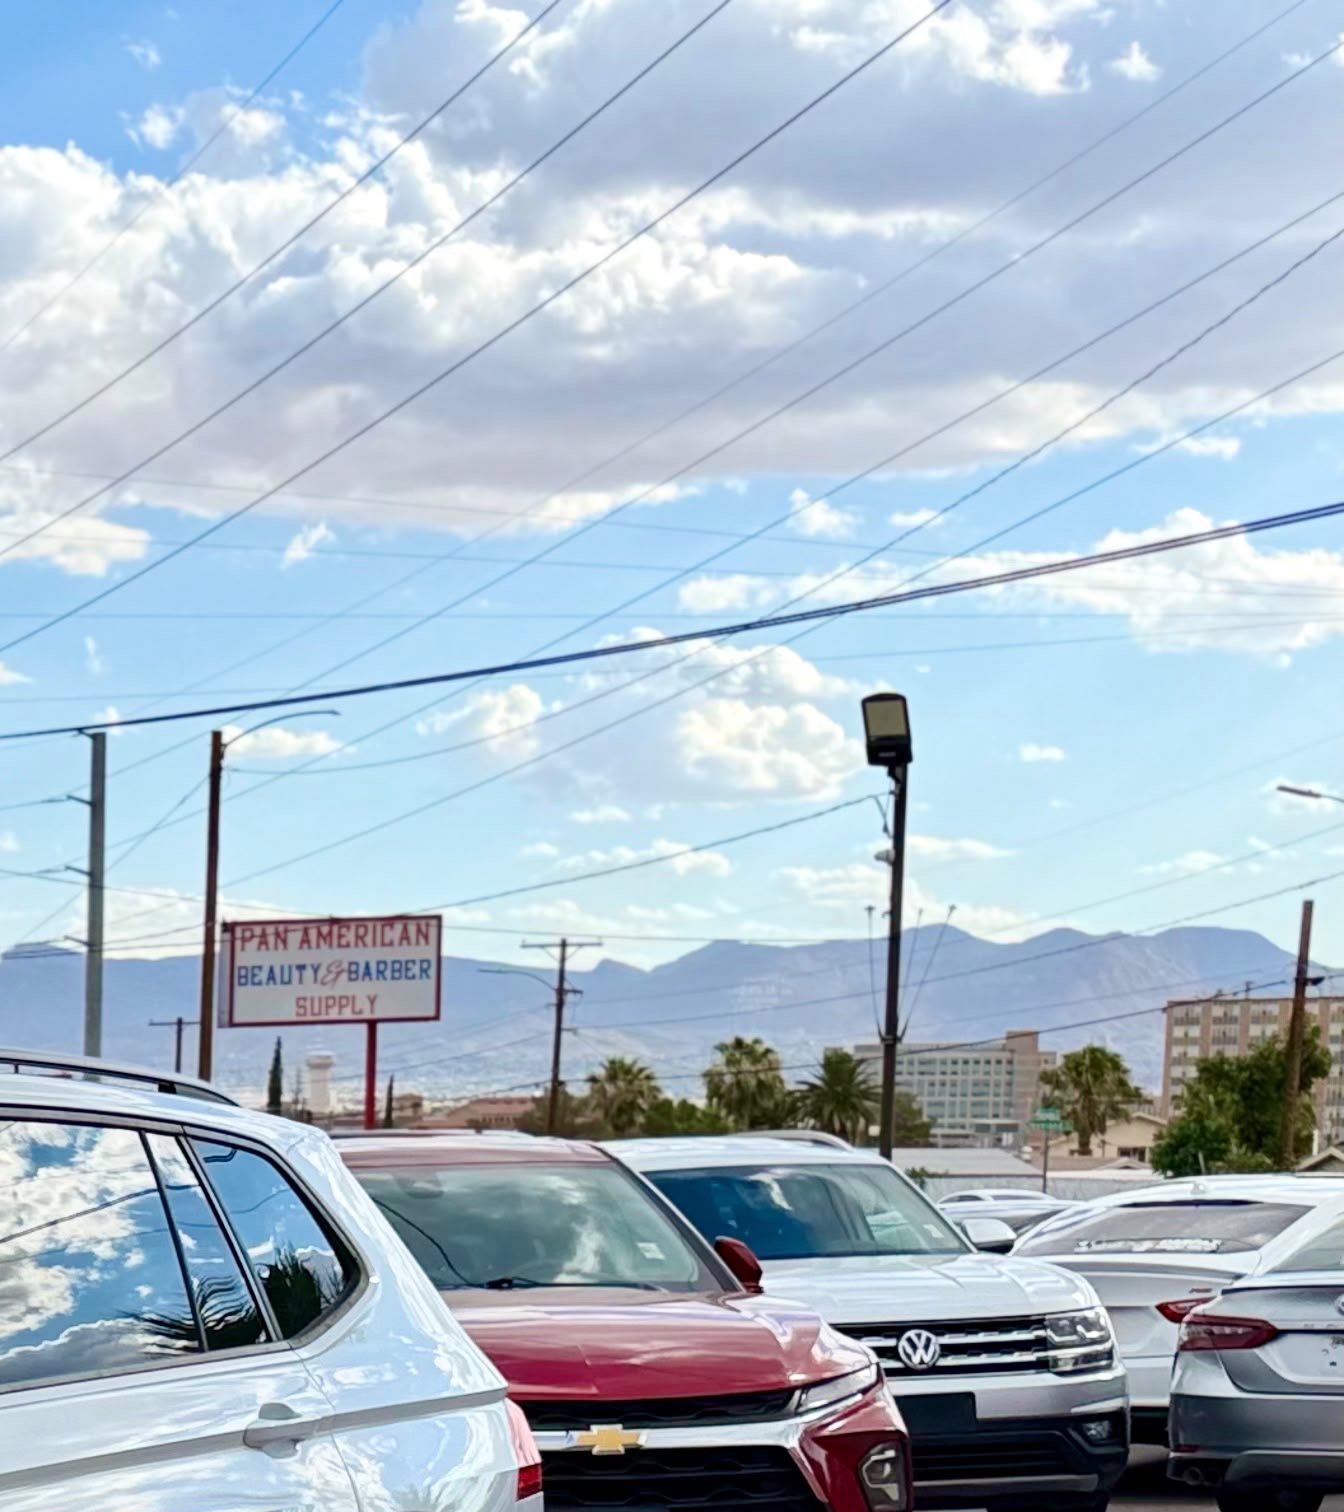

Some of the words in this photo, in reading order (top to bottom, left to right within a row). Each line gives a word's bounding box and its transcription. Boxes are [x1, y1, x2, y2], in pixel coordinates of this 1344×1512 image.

[240, 927, 288, 951] PAN
[298, 921, 430, 950] AMERICAN
[237, 963, 321, 986] BEAUTY
[320, 959, 348, 989] &
[348, 959, 432, 982] BARBER
[295, 993, 379, 1017] SUPPLY
